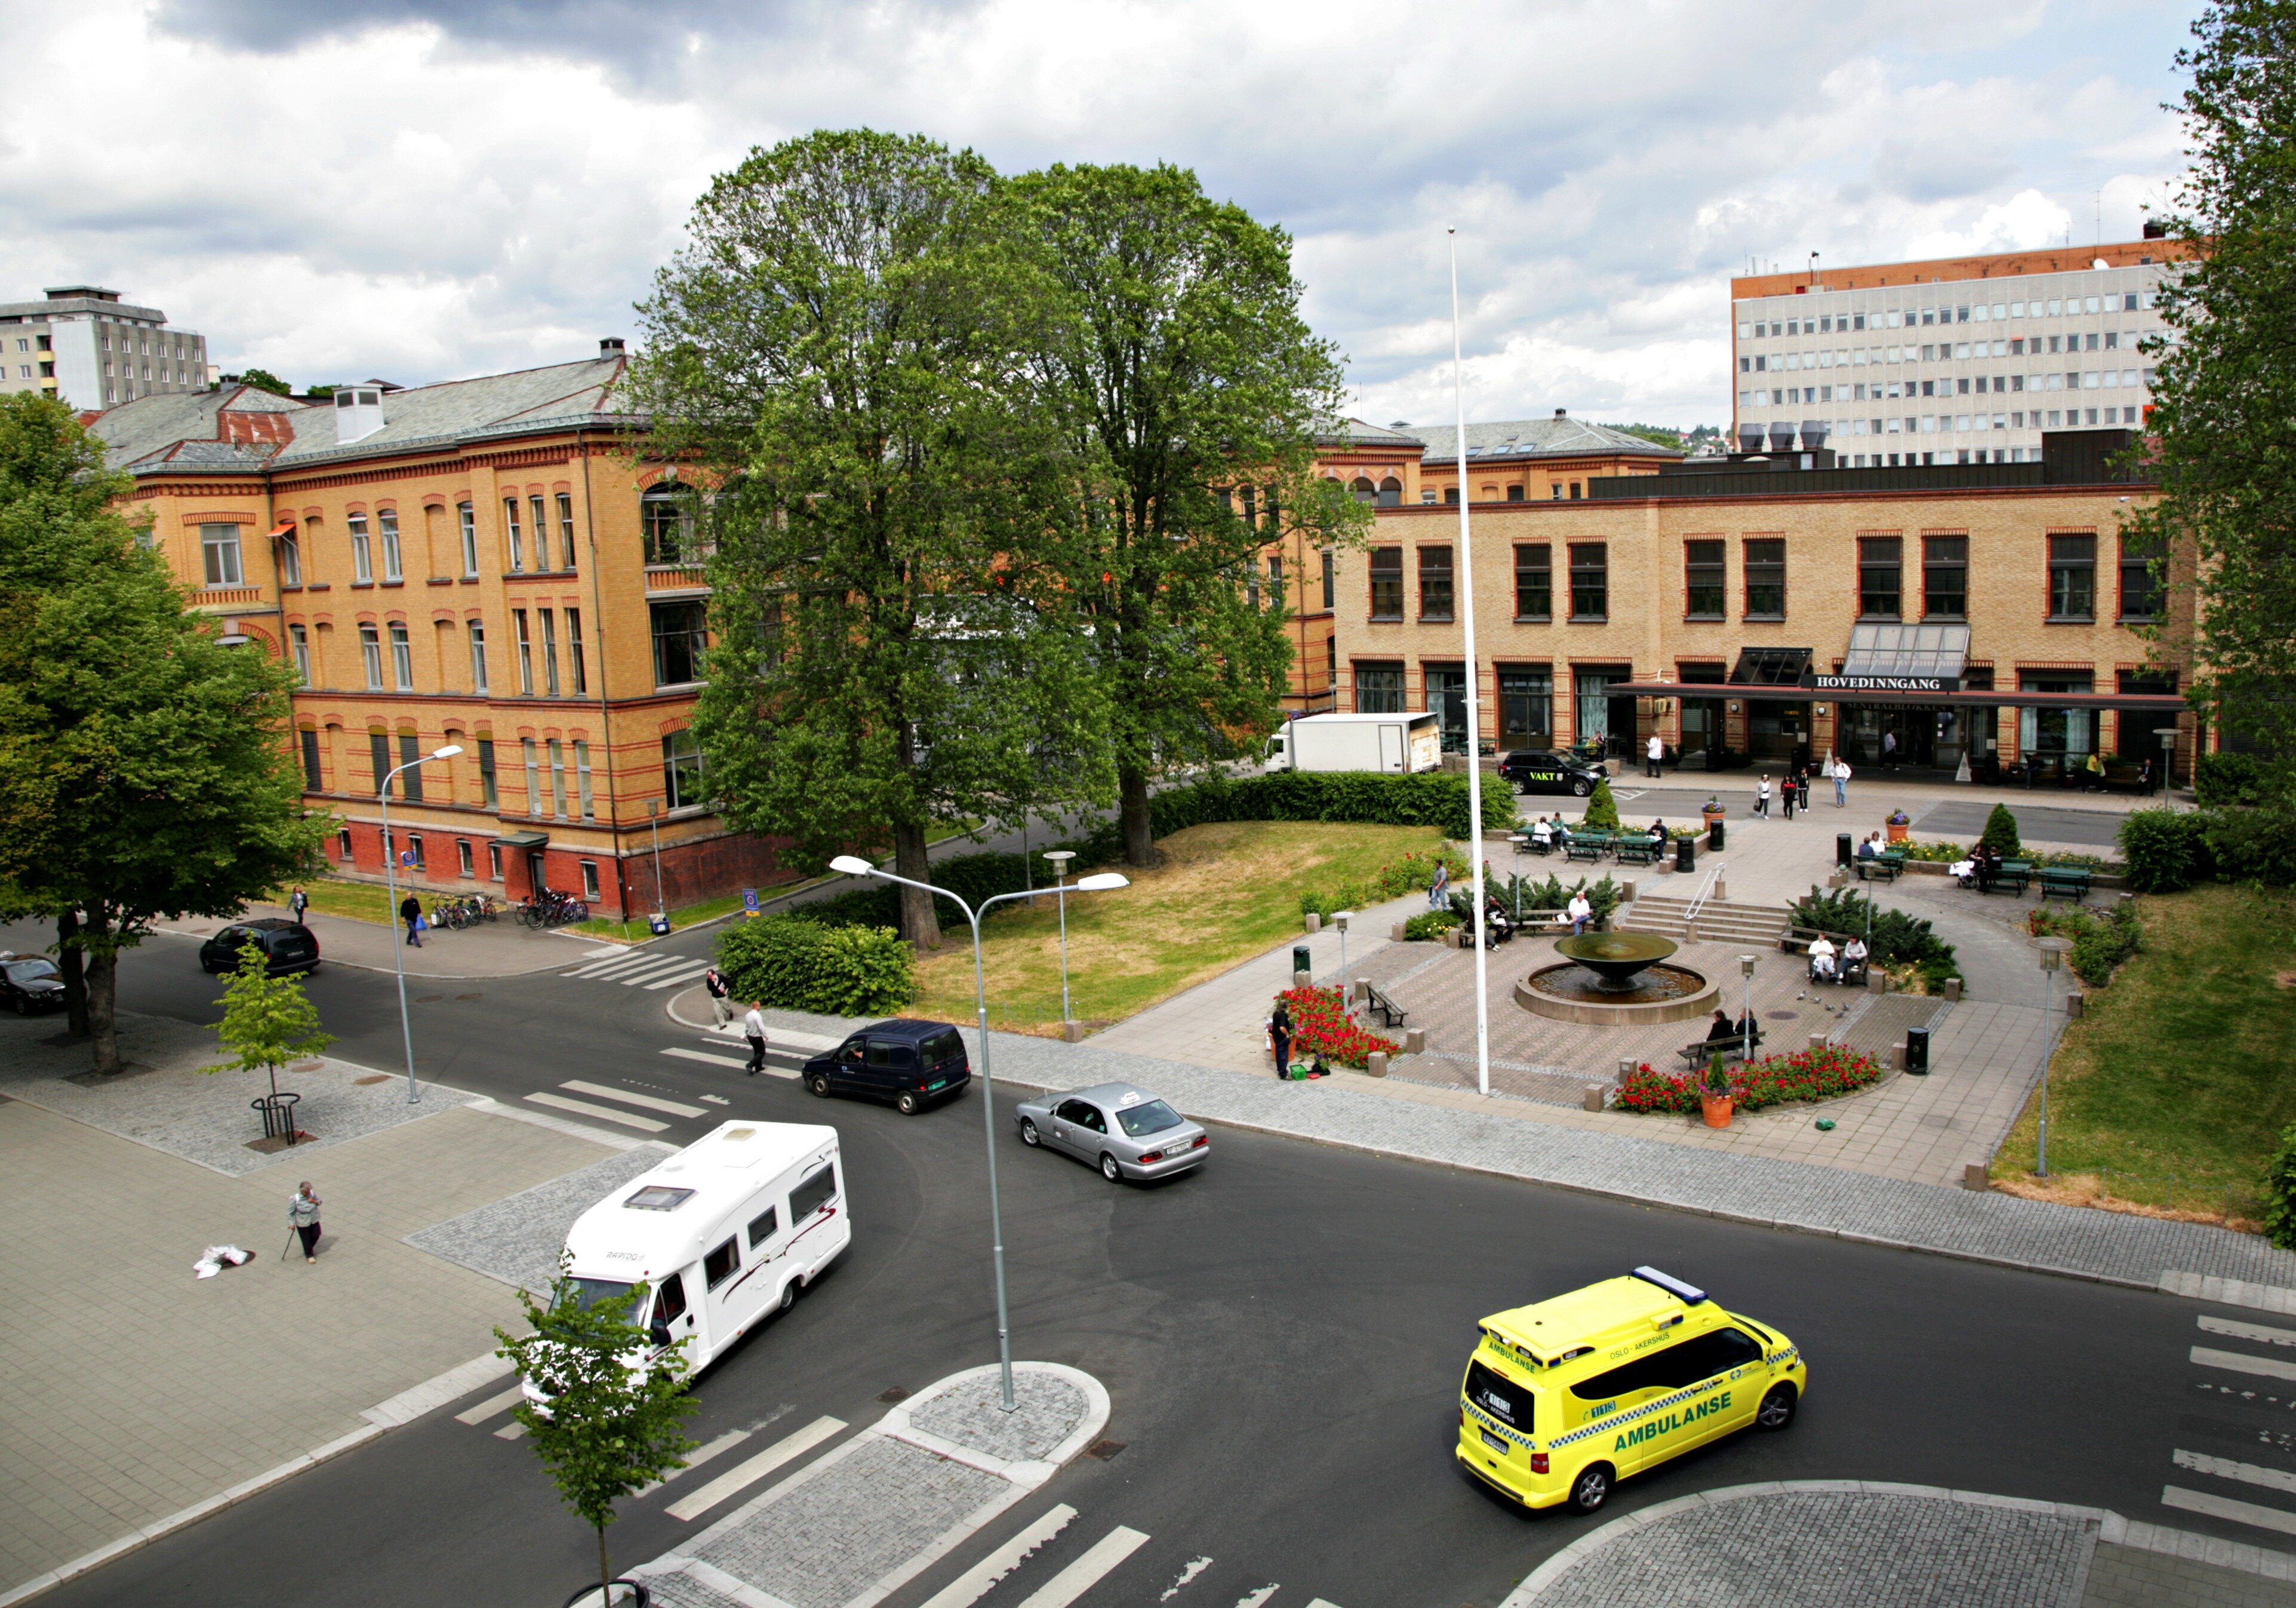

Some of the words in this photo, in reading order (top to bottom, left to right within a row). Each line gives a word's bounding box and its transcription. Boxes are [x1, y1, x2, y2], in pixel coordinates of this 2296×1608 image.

[1817, 676, 1941, 690] HOVEDINNGANG
[1529, 772, 1555, 781] VAKT
[1488, 1341, 1535, 1374] AMBULANSE
[1610, 1347, 1629, 1360] OSLO
[1635, 1332, 1670, 1351] AKERSHUS
[1476, 1396, 1487, 1407] OSLO
[1490, 1406, 1515, 1424] AKERSHUS
[1489, 1393, 1510, 1413] 113
[1591, 1400, 1616, 1418] 113
[1614, 1391, 1731, 1452] AMBULANSE
